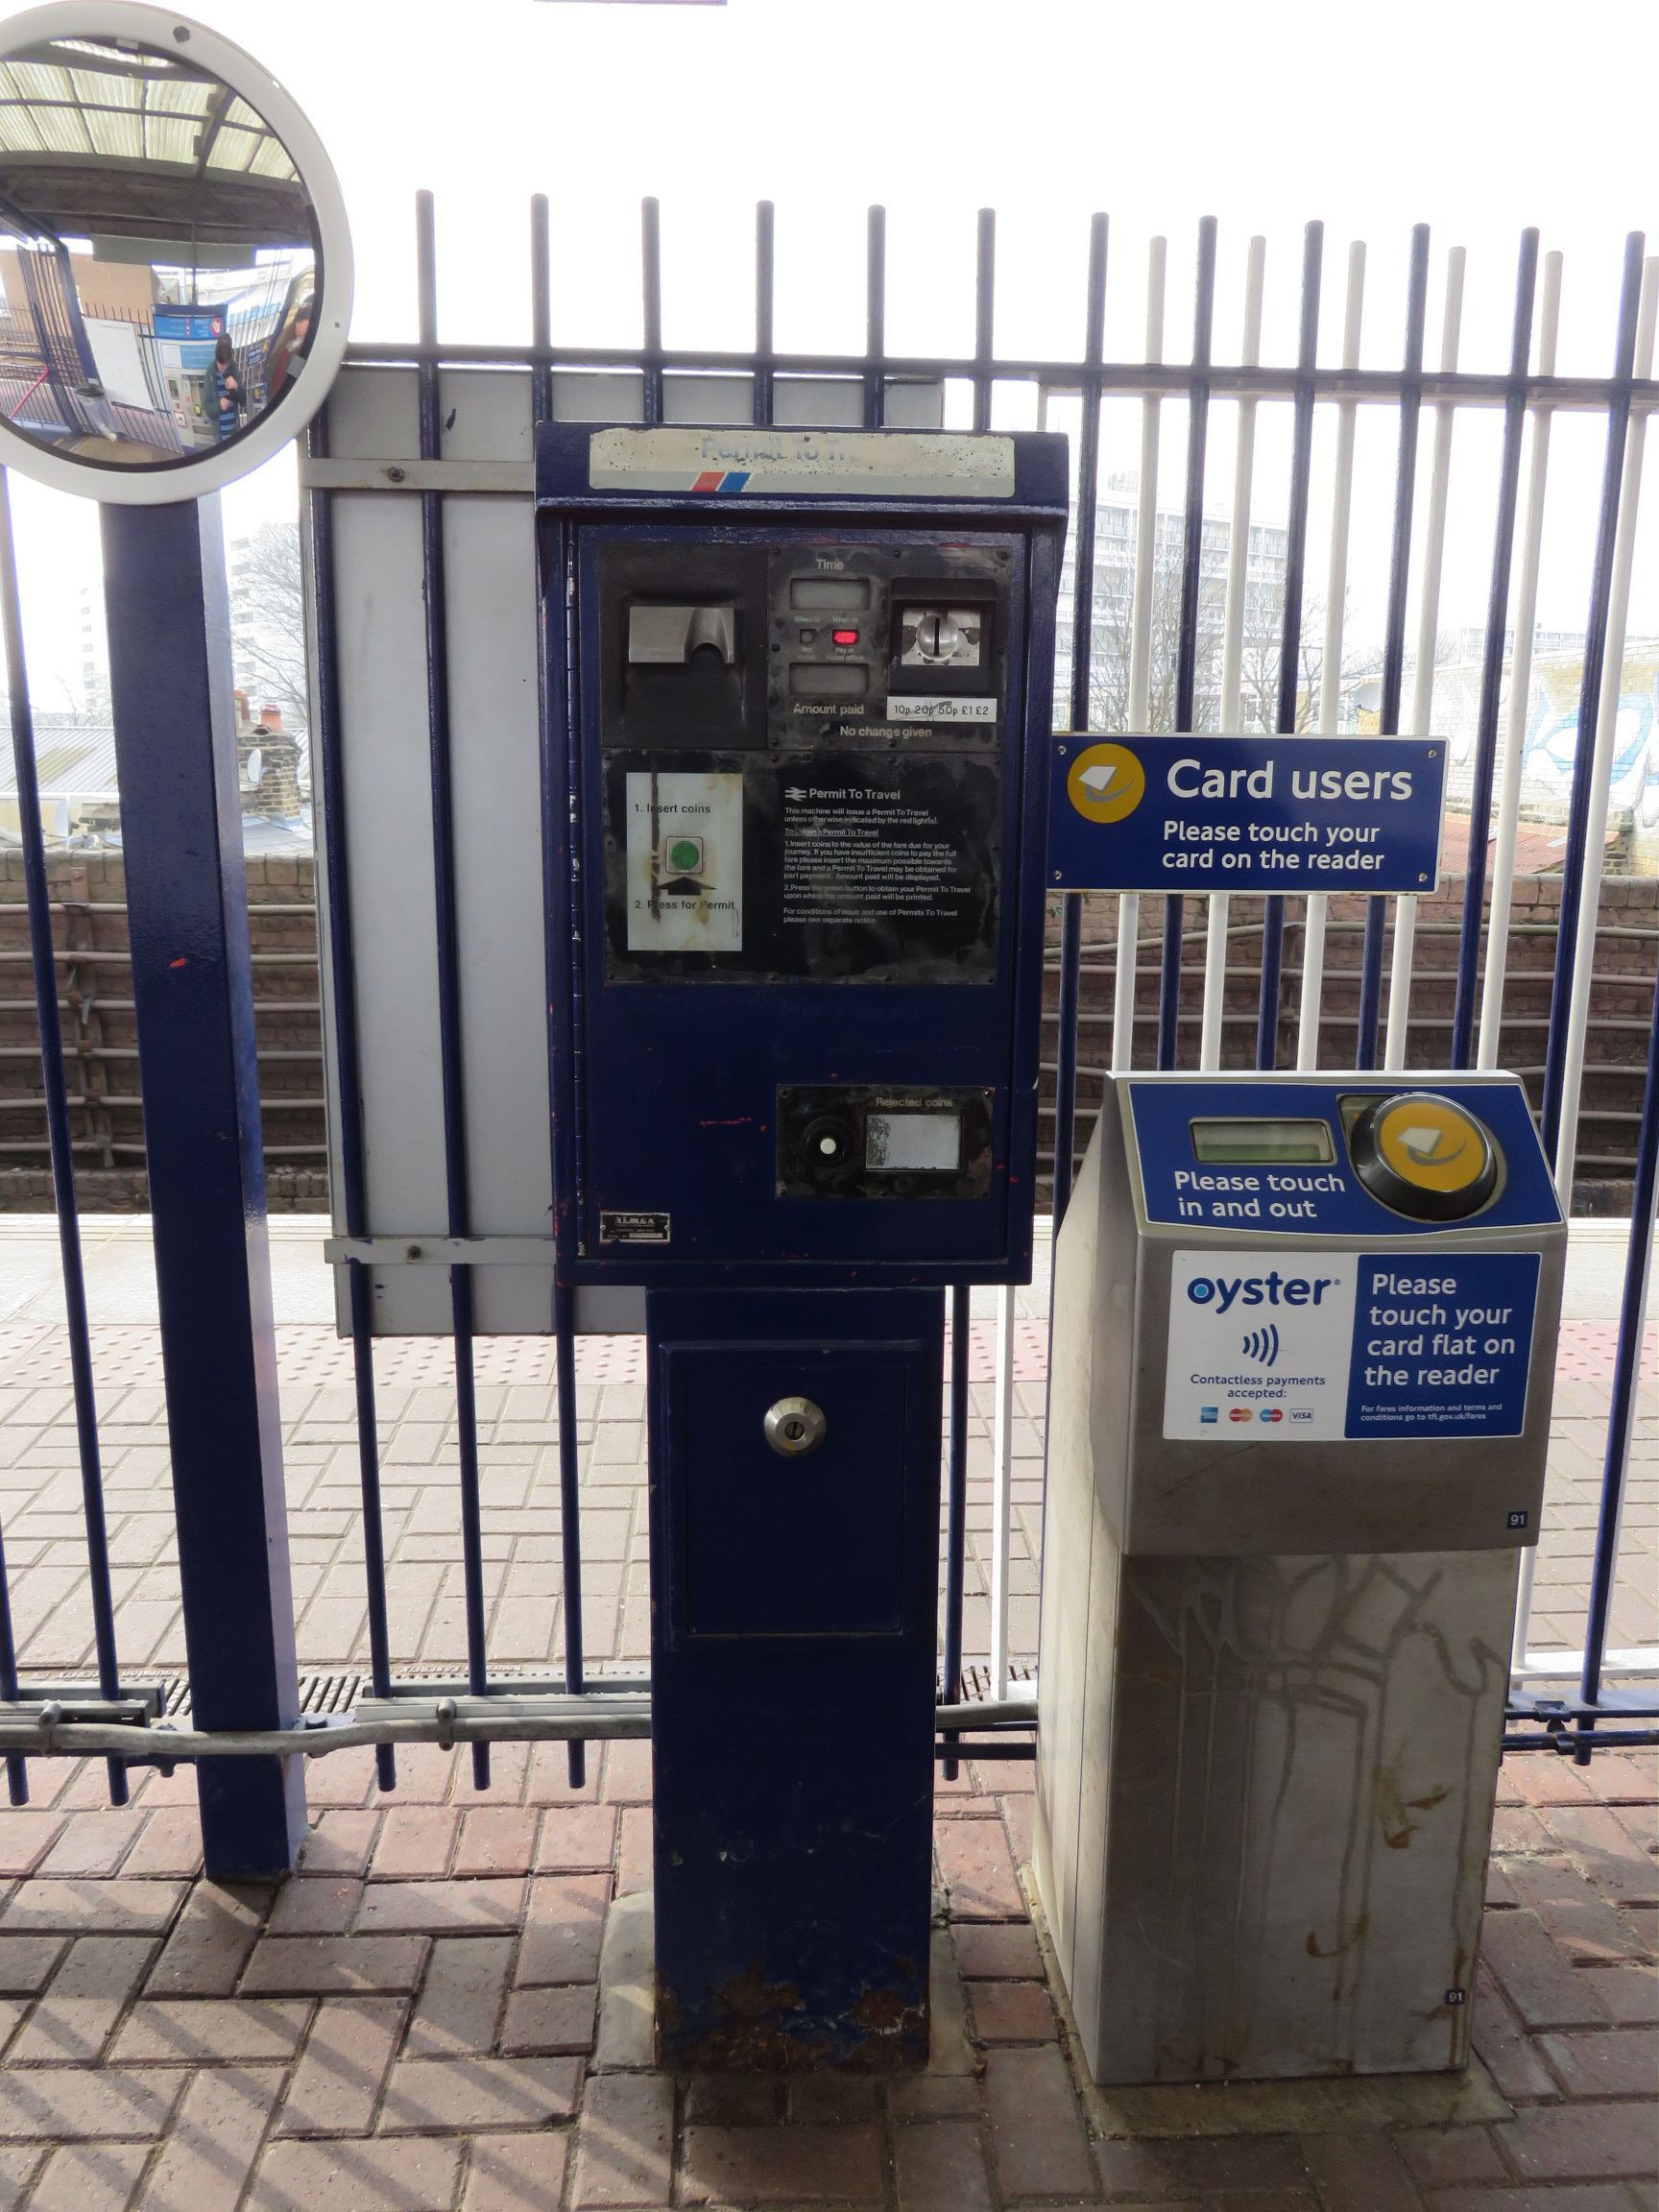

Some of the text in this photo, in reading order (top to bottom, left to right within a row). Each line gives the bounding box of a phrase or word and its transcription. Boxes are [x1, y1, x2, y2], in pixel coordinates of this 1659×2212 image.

[816, 559, 844, 570] Time
[793, 703, 864, 716] Amount paid
[894, 704, 989, 717] 10p 20p 50p £1 £2
[840, 726, 932, 739] No change given
[1166, 758, 1413, 801] Card users
[809, 788, 901, 800] Permit To Travel
[635, 804, 644, 813] 1.
[681, 804, 711, 813] coins
[784, 806, 800, 815] This
[801, 807, 831, 815] machine
[877, 817, 886, 825] by
[857, 829, 879, 837] Travel
[1163, 820, 1381, 847] Please touch your
[1162, 848, 1385, 870] card on the reader
[635, 900, 644, 909] 2.
[648, 900, 678, 909] Pess
[681, 900, 697, 910] for
[876, 1096, 953, 1108] Rejected coins
[1174, 1171, 1346, 1192] Please touch
[1178, 1197, 1318, 1218] in and out
[1372, 1273, 1457, 1295] Please
[1370, 1303, 1513, 1331] touch your
[1367, 1334, 1515, 1356] card flat on
[1190, 1374, 1326, 1387] Contactless payments
[1364, 1364, 1500, 1386] the reader
[1227, 1388, 1287, 1400] accepted:
[1361, 1403, 1503, 1413] For fares information and terms and
[1405, 1414, 1415, 1422] go
[1427, 1413, 1486, 1422] tfl.gov.uk/fares
[1510, 1514, 1525, 1526] 91
[1449, 1992, 1463, 2002] 91
